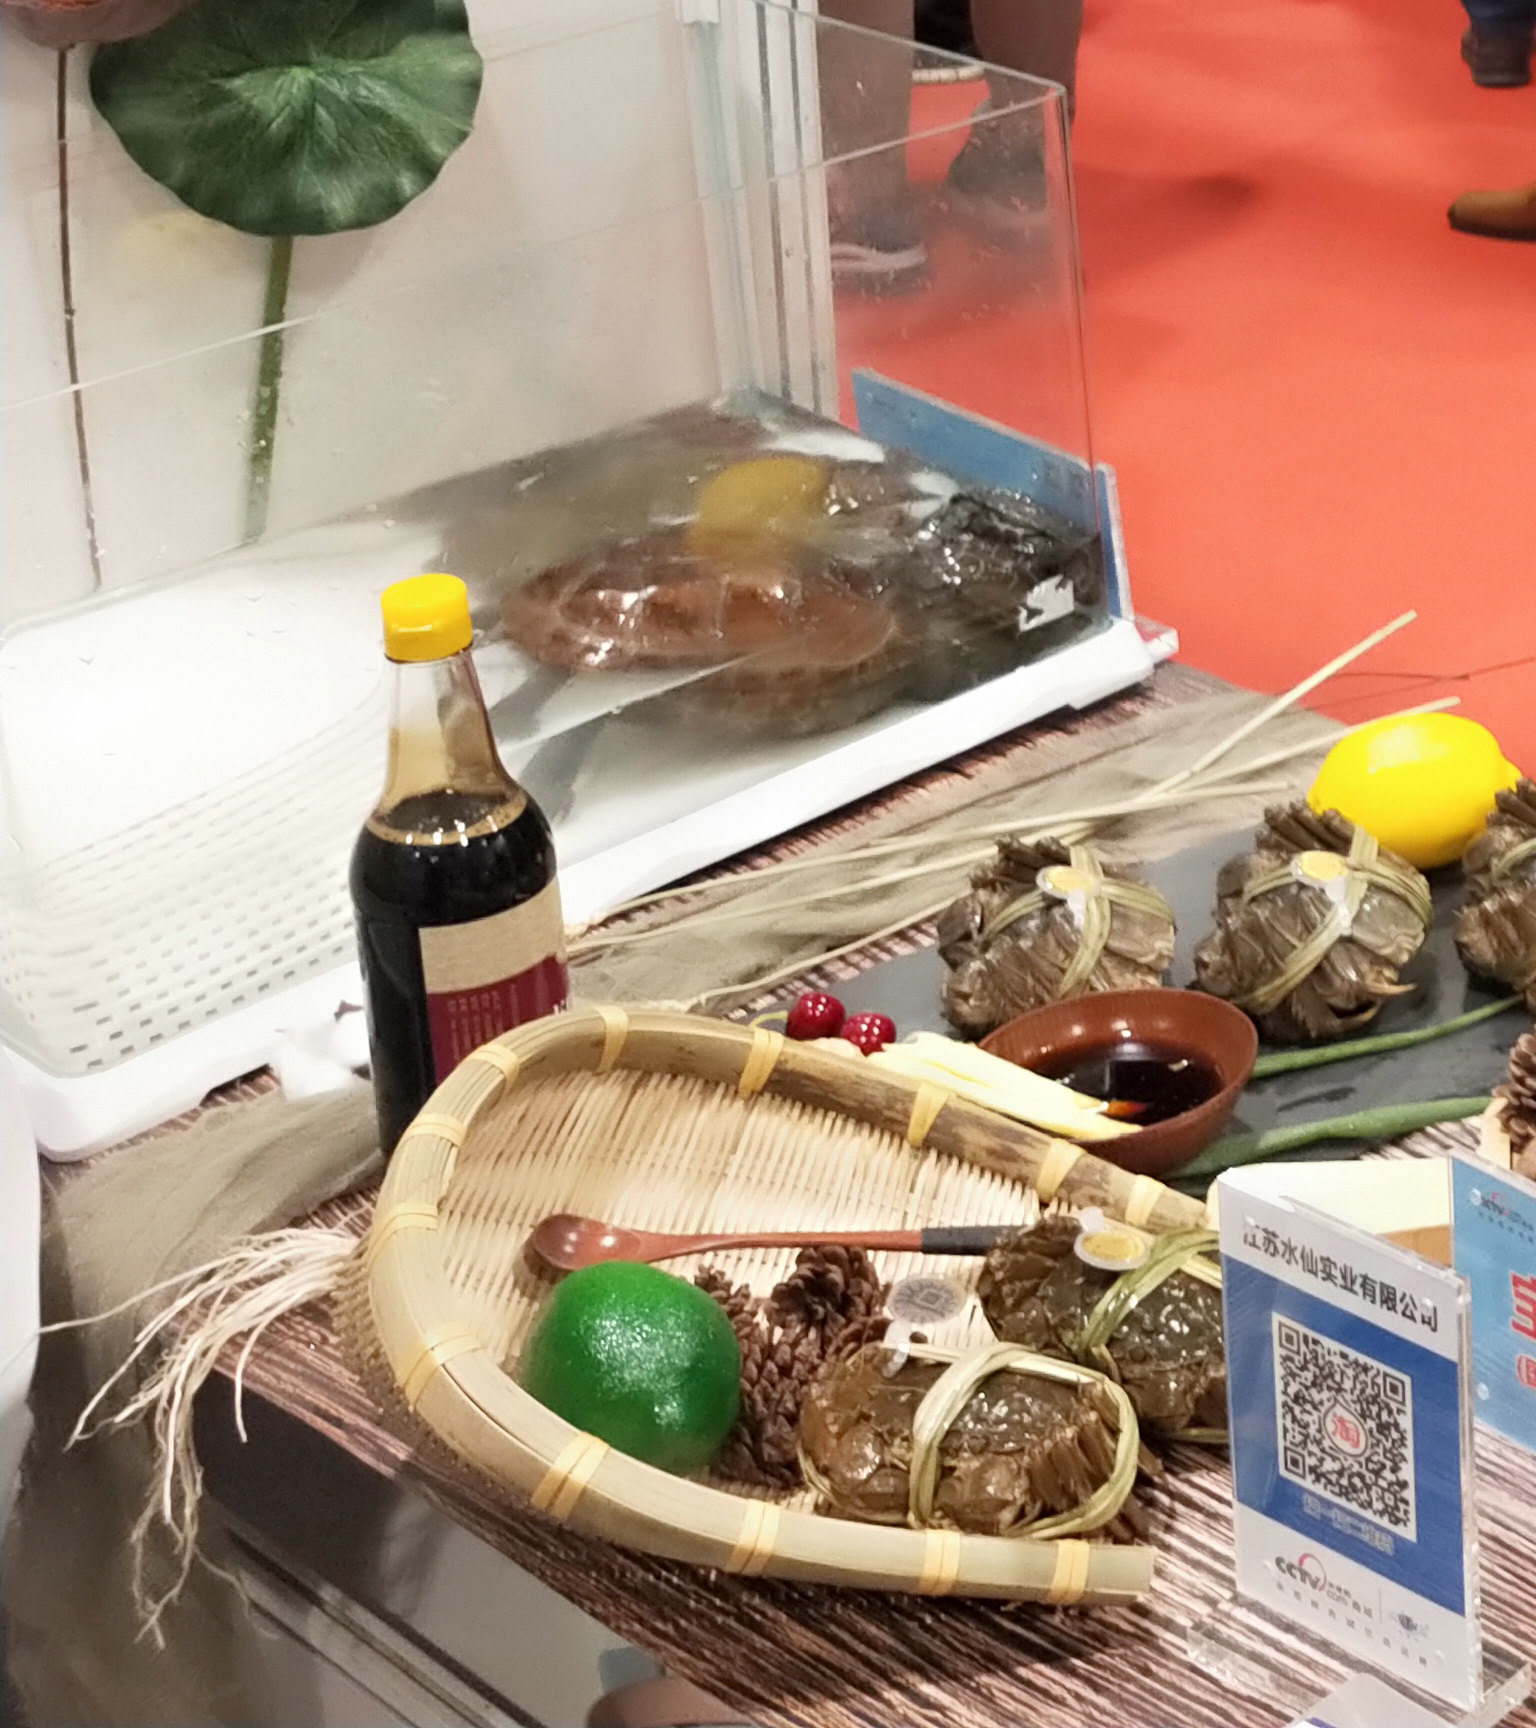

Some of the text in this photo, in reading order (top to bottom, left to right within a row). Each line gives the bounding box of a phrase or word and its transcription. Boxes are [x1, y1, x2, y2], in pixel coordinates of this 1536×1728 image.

[1242, 1222, 1439, 1335] 江苏水仙实业有限公司
